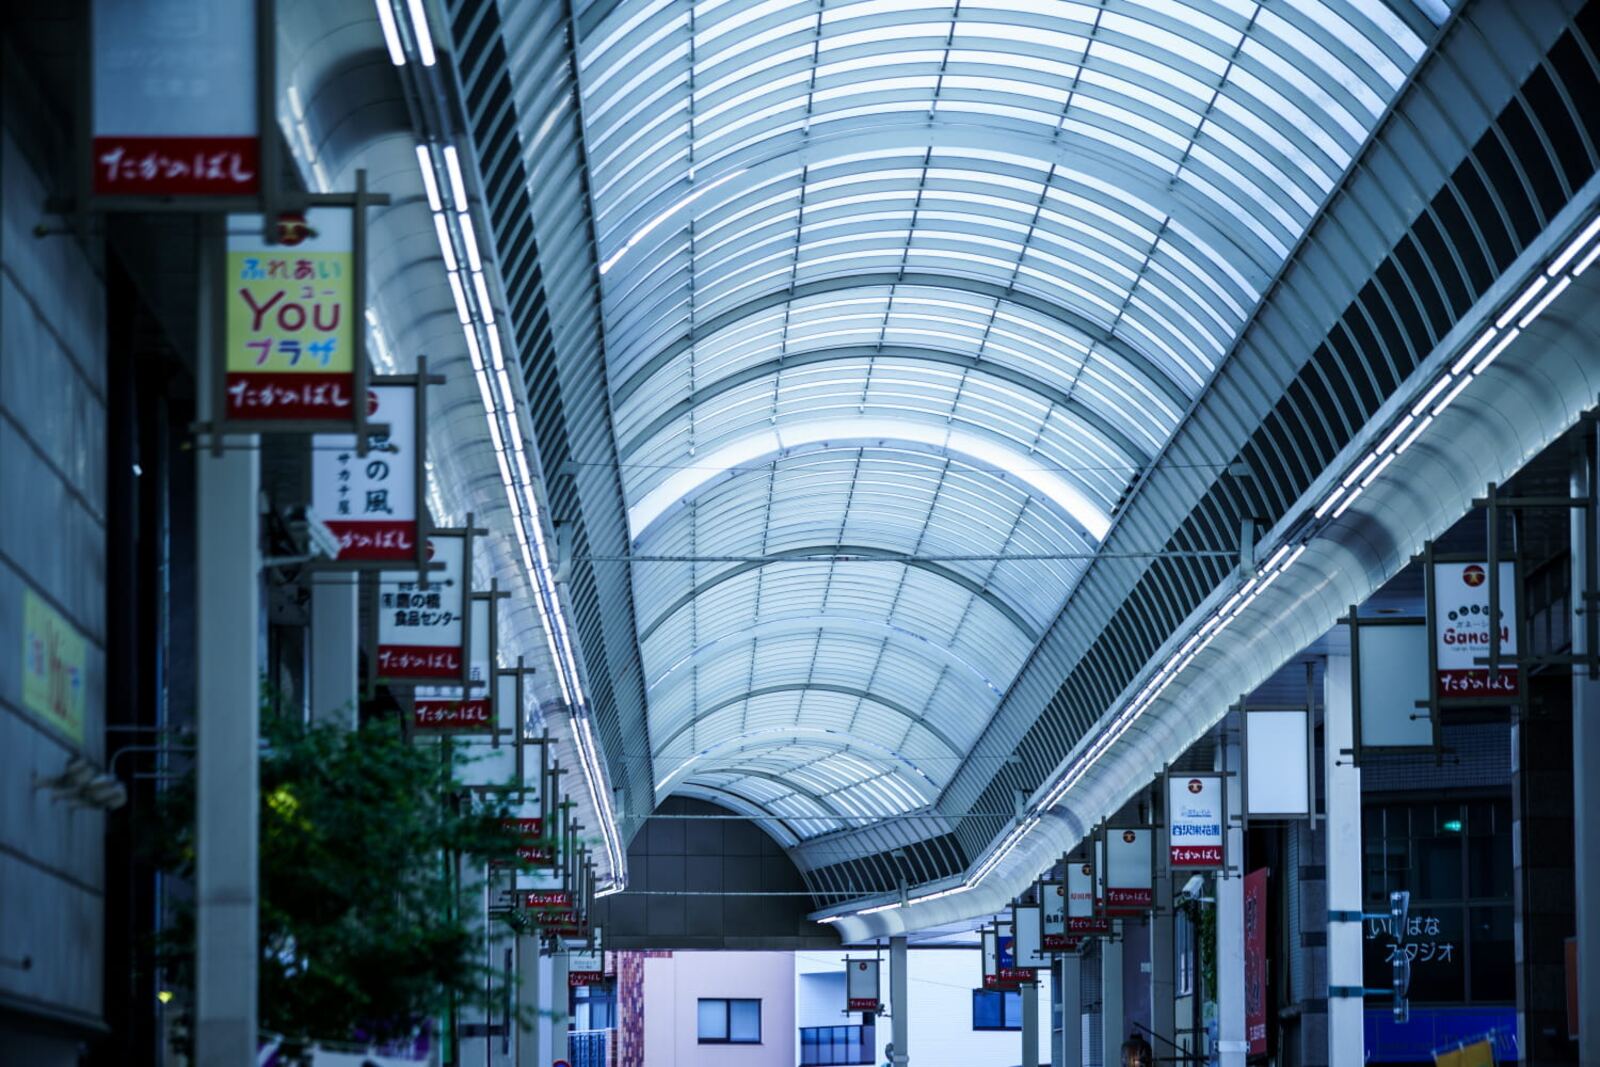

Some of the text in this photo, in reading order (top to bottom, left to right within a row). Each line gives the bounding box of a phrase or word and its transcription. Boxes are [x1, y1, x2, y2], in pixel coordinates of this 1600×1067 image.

[98, 144, 256, 185] たかのばし
[240, 258, 342, 280] ふれあい
[245, 338, 337, 366] プラザ
[228, 380, 351, 408] たかのばし
[339, 530, 414, 551] かのばし
[394, 611, 462, 627] 食品センター
[1443, 627, 1509, 645] GaneH
[380, 650, 460, 670] たかのばし
[1440, 674, 1516, 692] たかのばし
[1172, 848, 1221, 861] たかのばし
